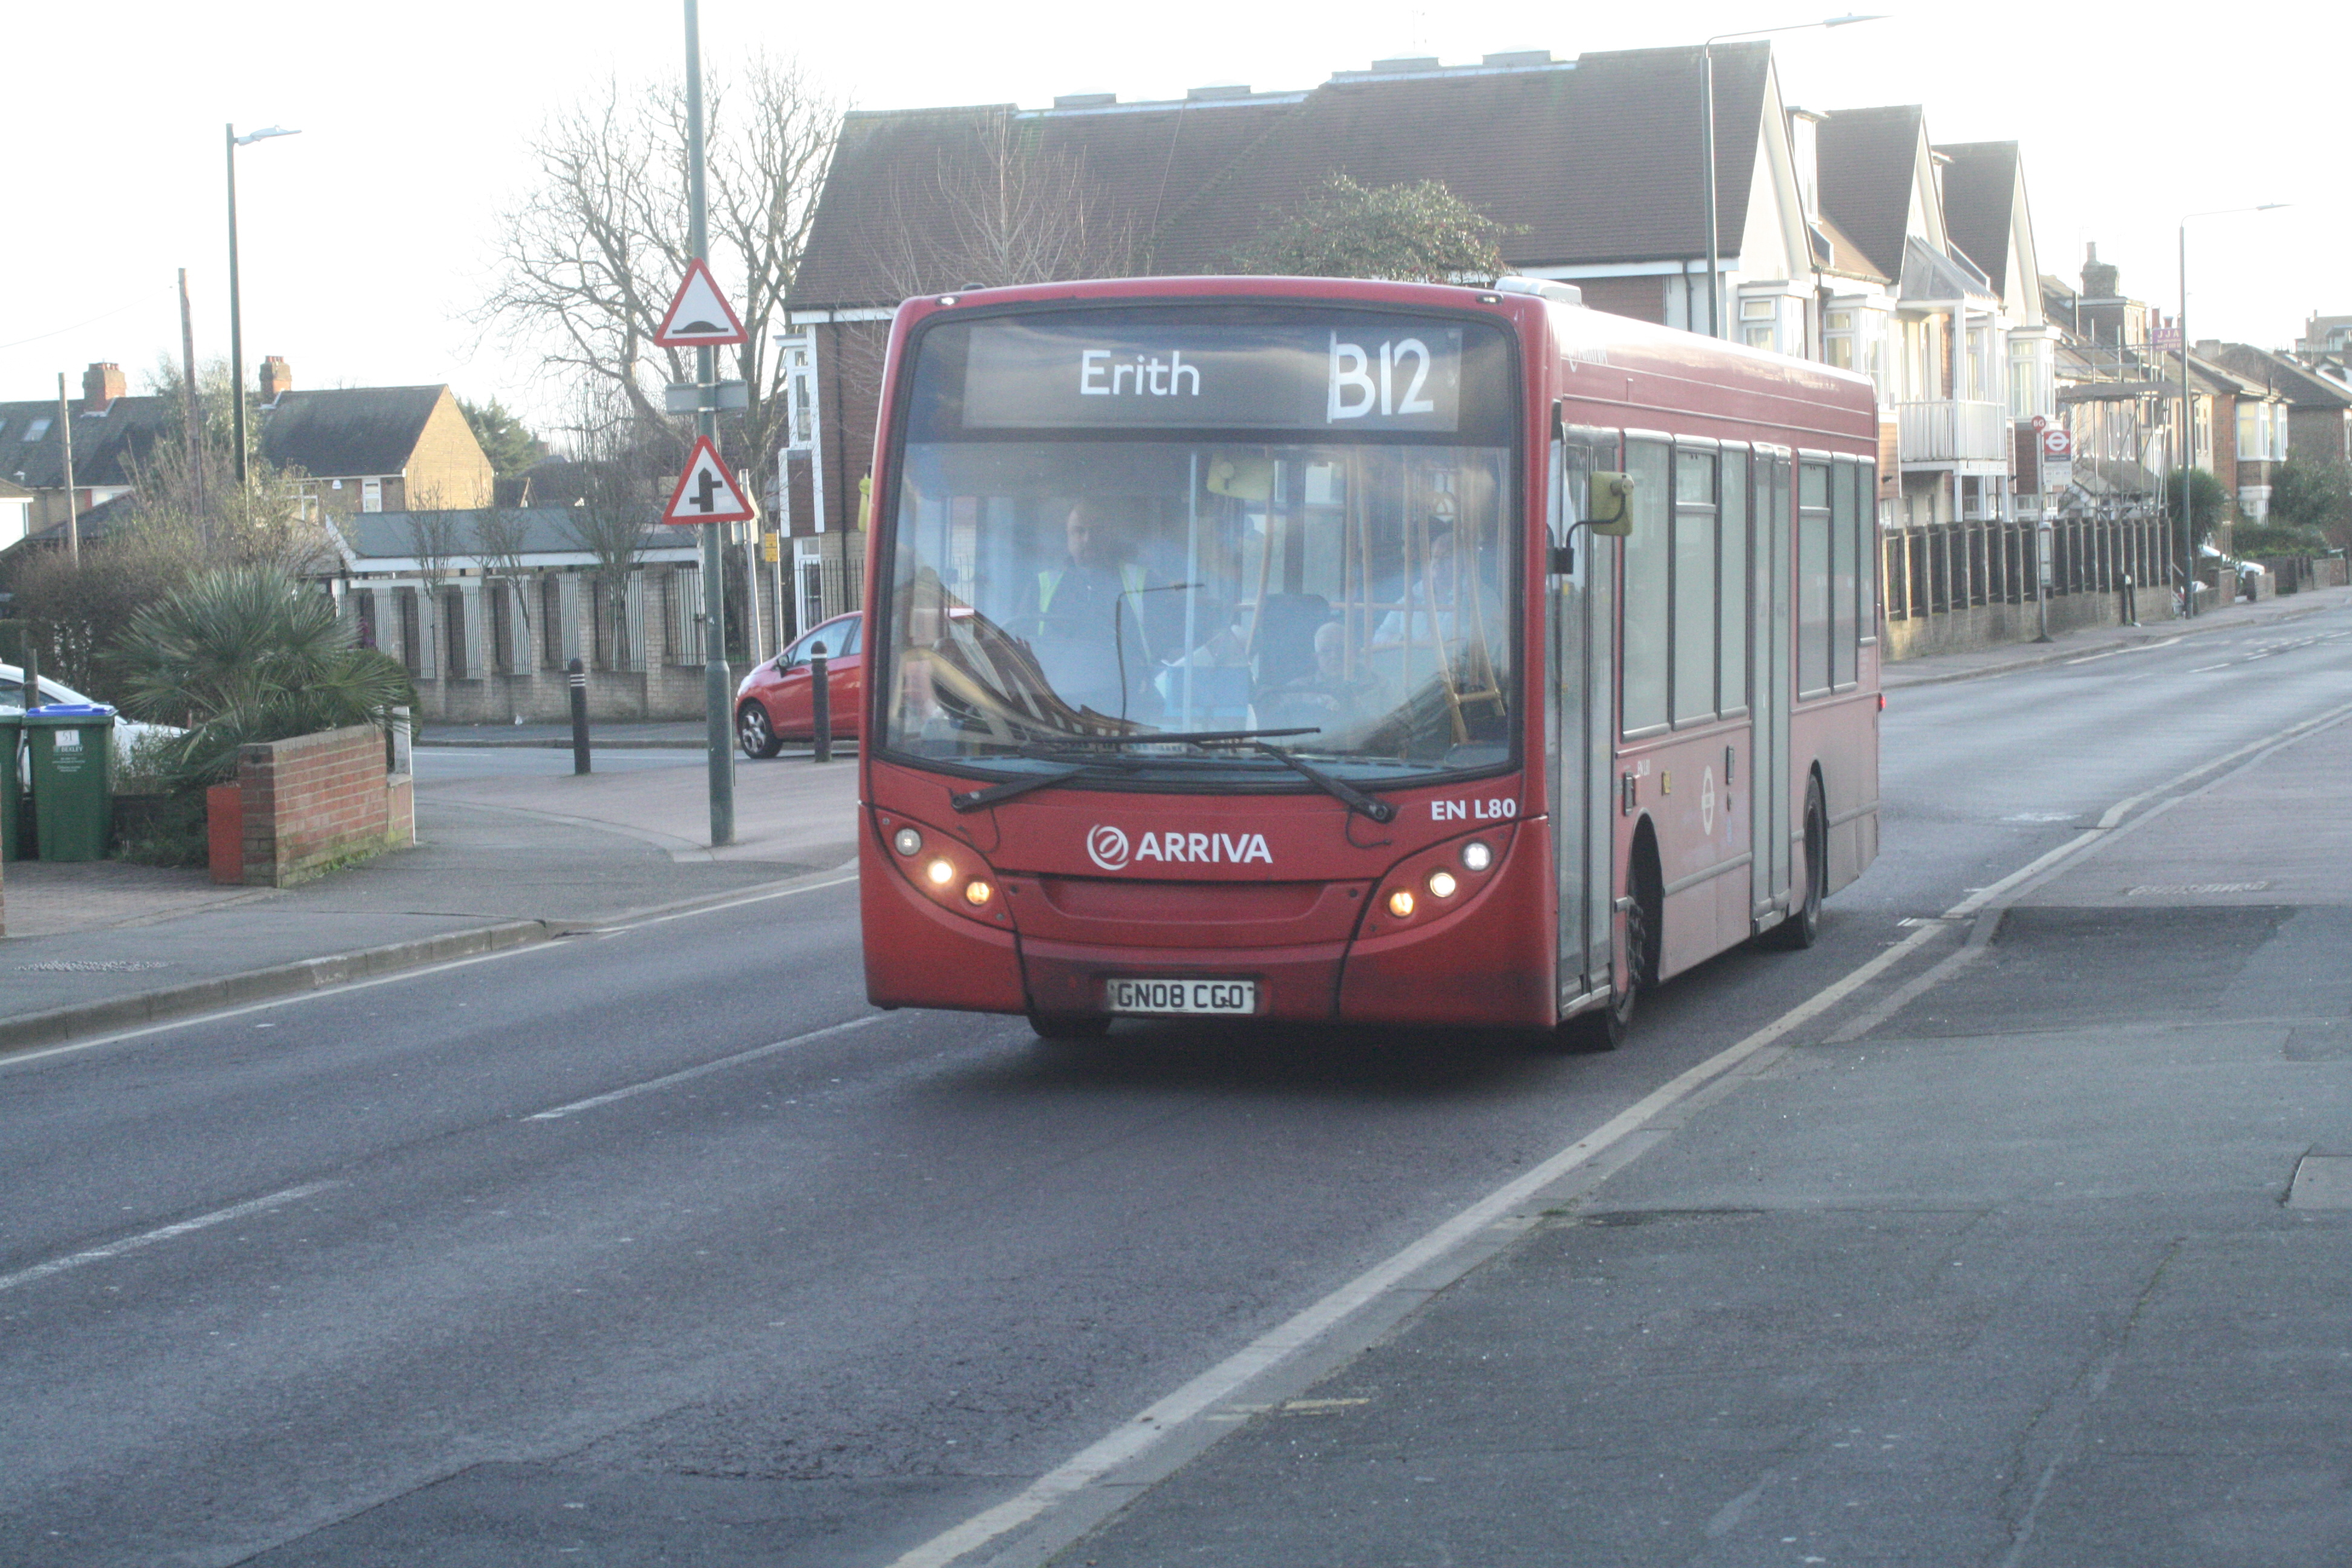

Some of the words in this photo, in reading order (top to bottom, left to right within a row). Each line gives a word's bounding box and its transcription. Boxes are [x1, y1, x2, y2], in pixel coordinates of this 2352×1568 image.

[1080, 350, 1200, 396] Erith
[1330, 337, 1434, 420] B12
[2033, 419, 2045, 428] BG
[1431, 800, 1466, 820] EN
[1474, 798, 1517, 819] L80
[1135, 832, 1273, 864] ARRIVA
[1119, 984, 1184, 1008] GN08
[1194, 984, 1244, 1009] CGO
